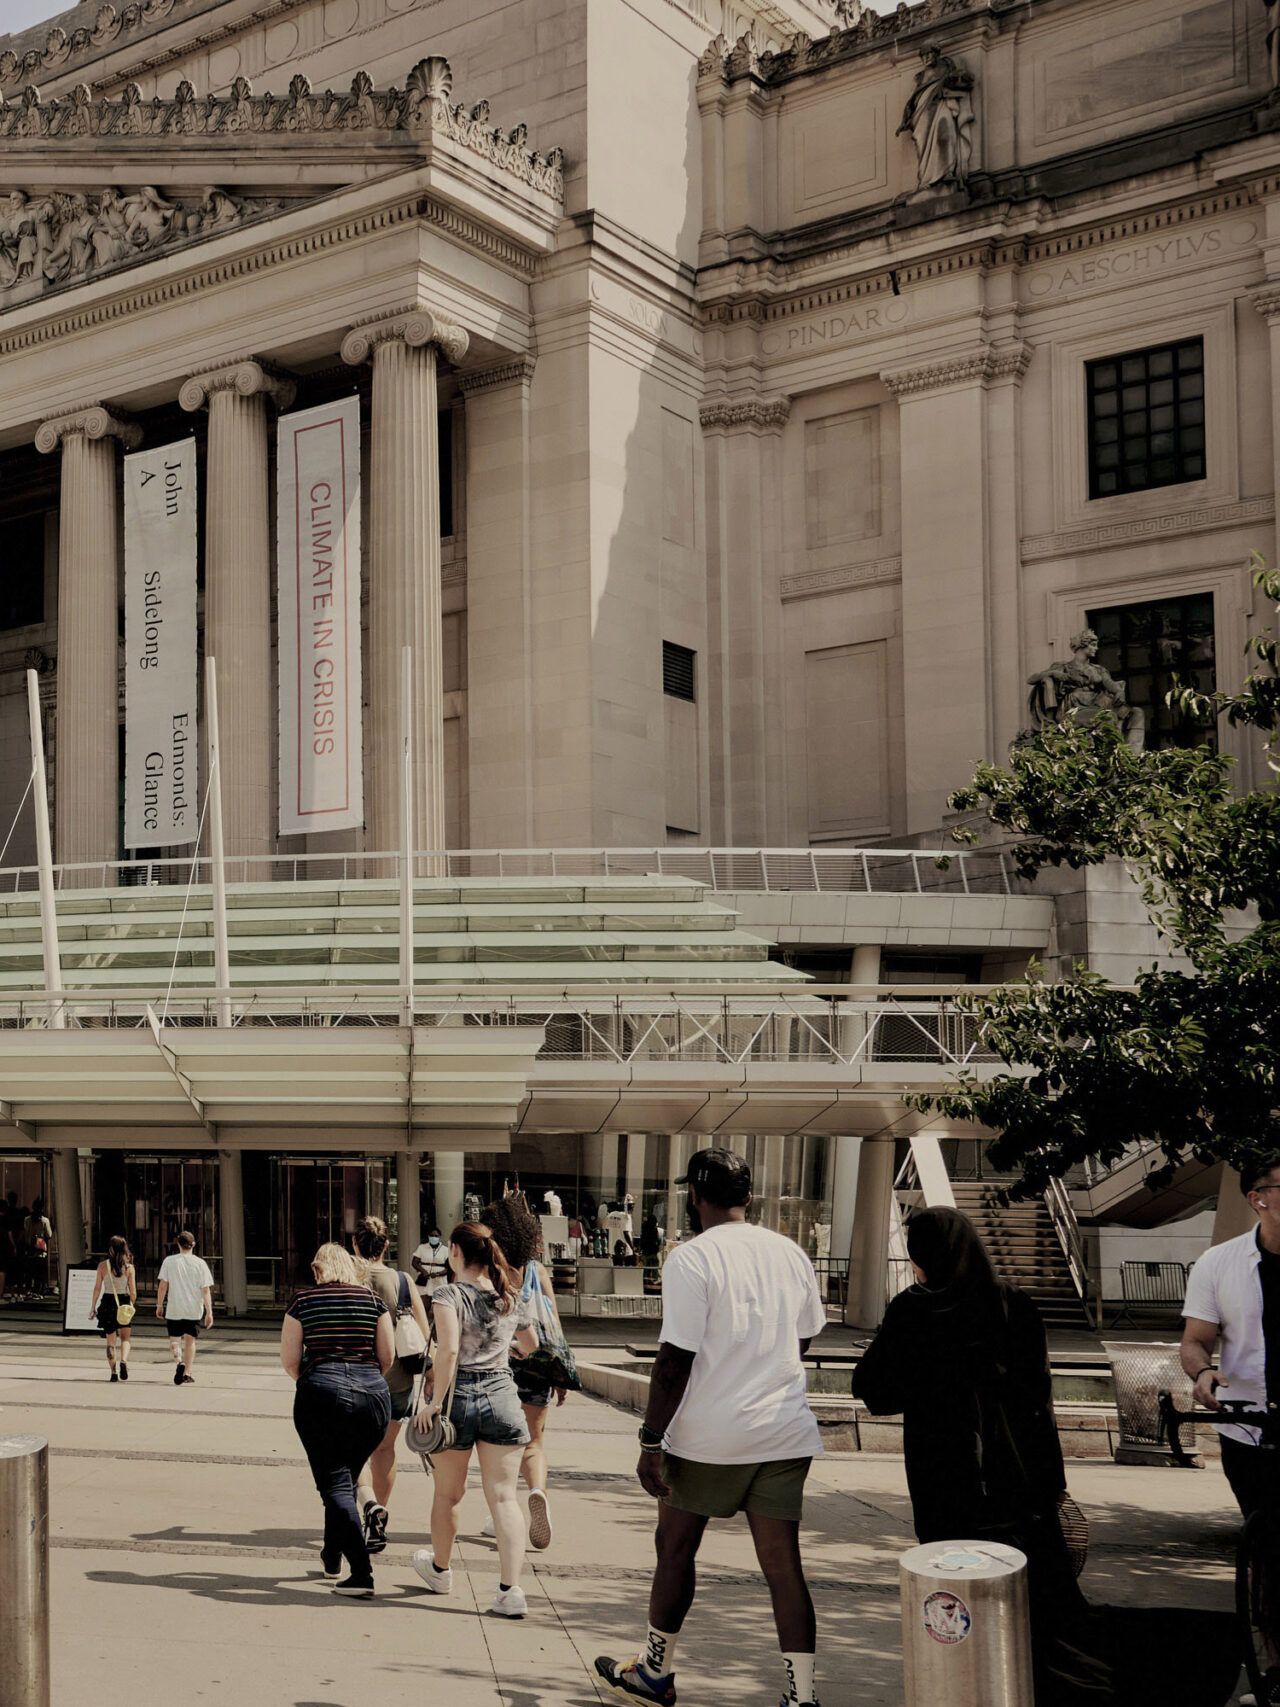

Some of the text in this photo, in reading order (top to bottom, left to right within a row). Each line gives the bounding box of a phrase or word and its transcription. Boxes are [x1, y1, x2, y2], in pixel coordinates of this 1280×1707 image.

[787, 308, 882, 350] PINDAR
[1058, 229, 1221, 290] AESCHYLVS
[139, 469, 164, 830] A Sidelong Glance
[164, 461, 189, 827] John Edmonds:
[310, 482, 335, 756] CLIMATE IN CRISIS
